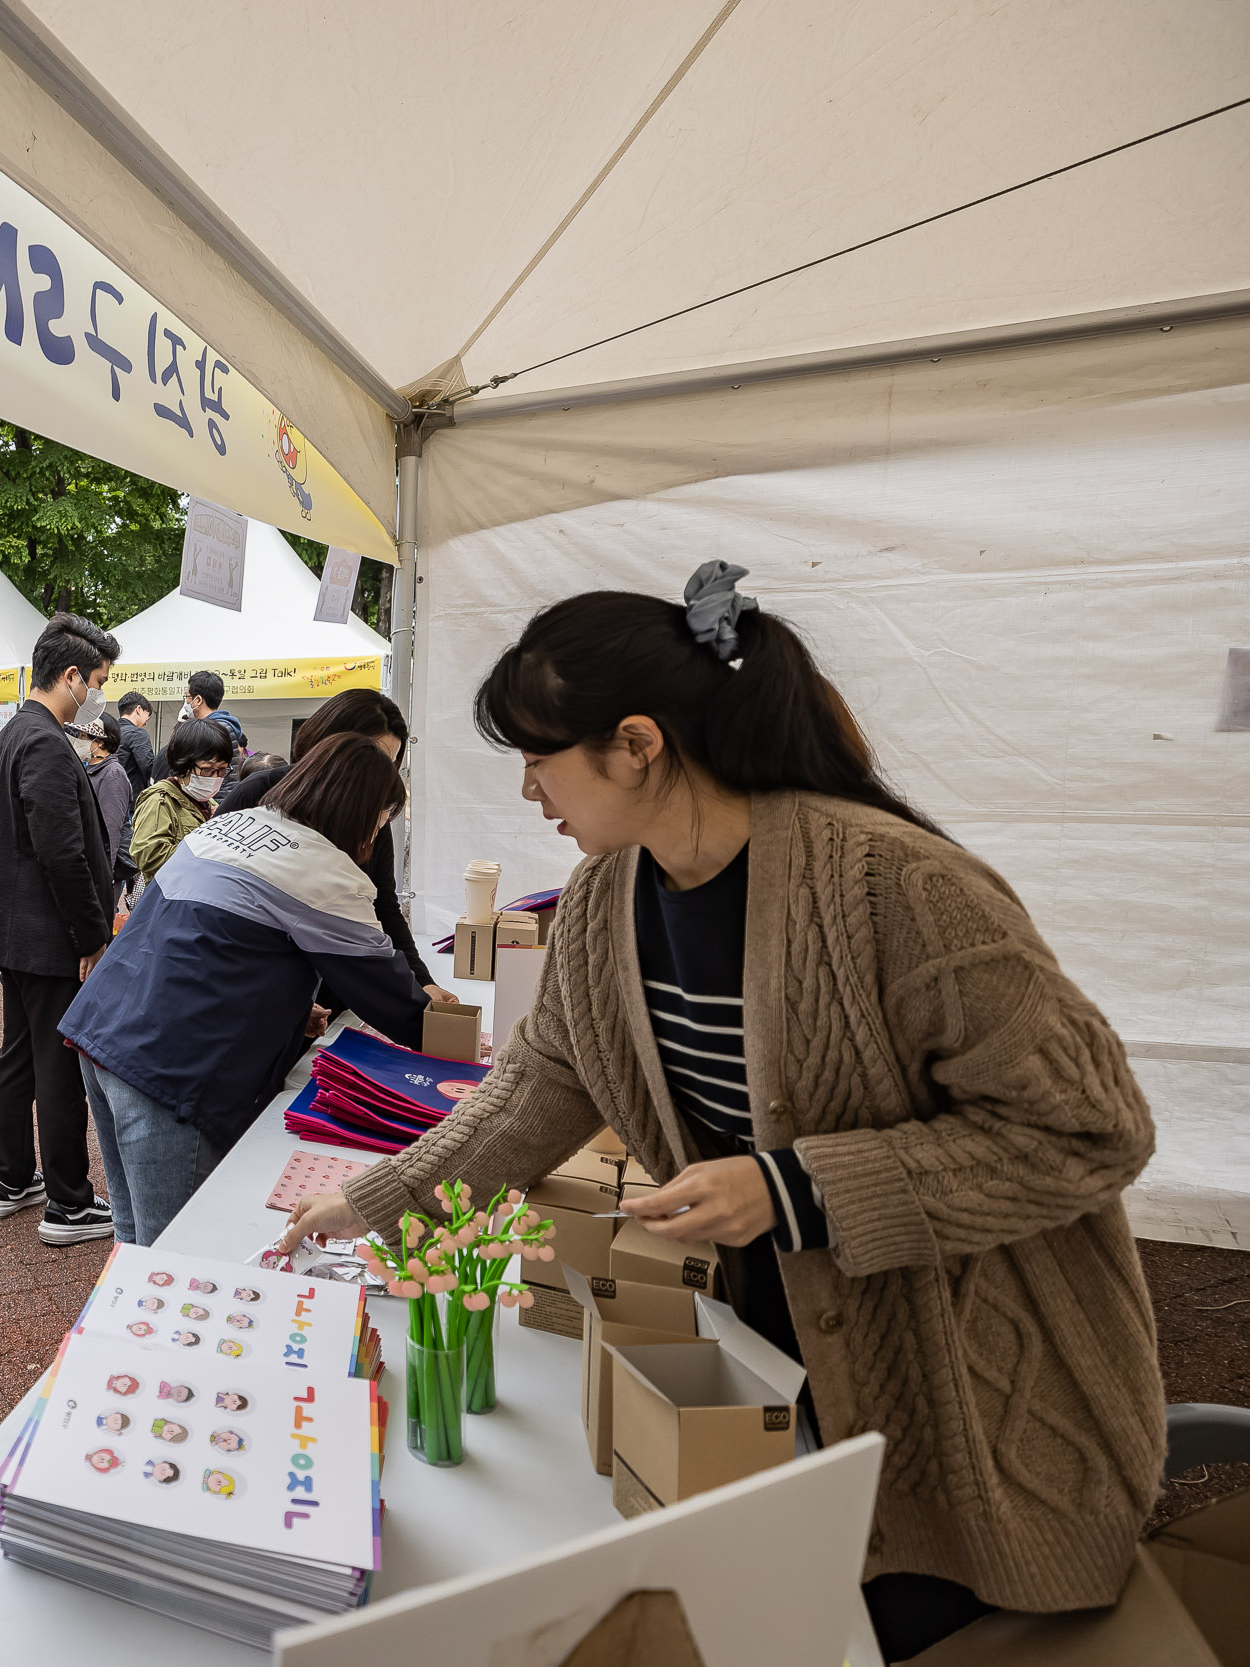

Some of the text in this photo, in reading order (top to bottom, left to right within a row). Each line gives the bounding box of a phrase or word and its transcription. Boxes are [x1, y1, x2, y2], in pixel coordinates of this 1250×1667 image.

[157, 670, 192, 682] 바람개비
[249, 668, 268, 679] 그립
[271, 667, 297, 678] Talk!
[205, 832, 254, 859] PROPERTY
[684, 1269, 707, 1284] ECO
[593, 1279, 615, 1292] ECO
[765, 1411, 790, 1424] ECO
